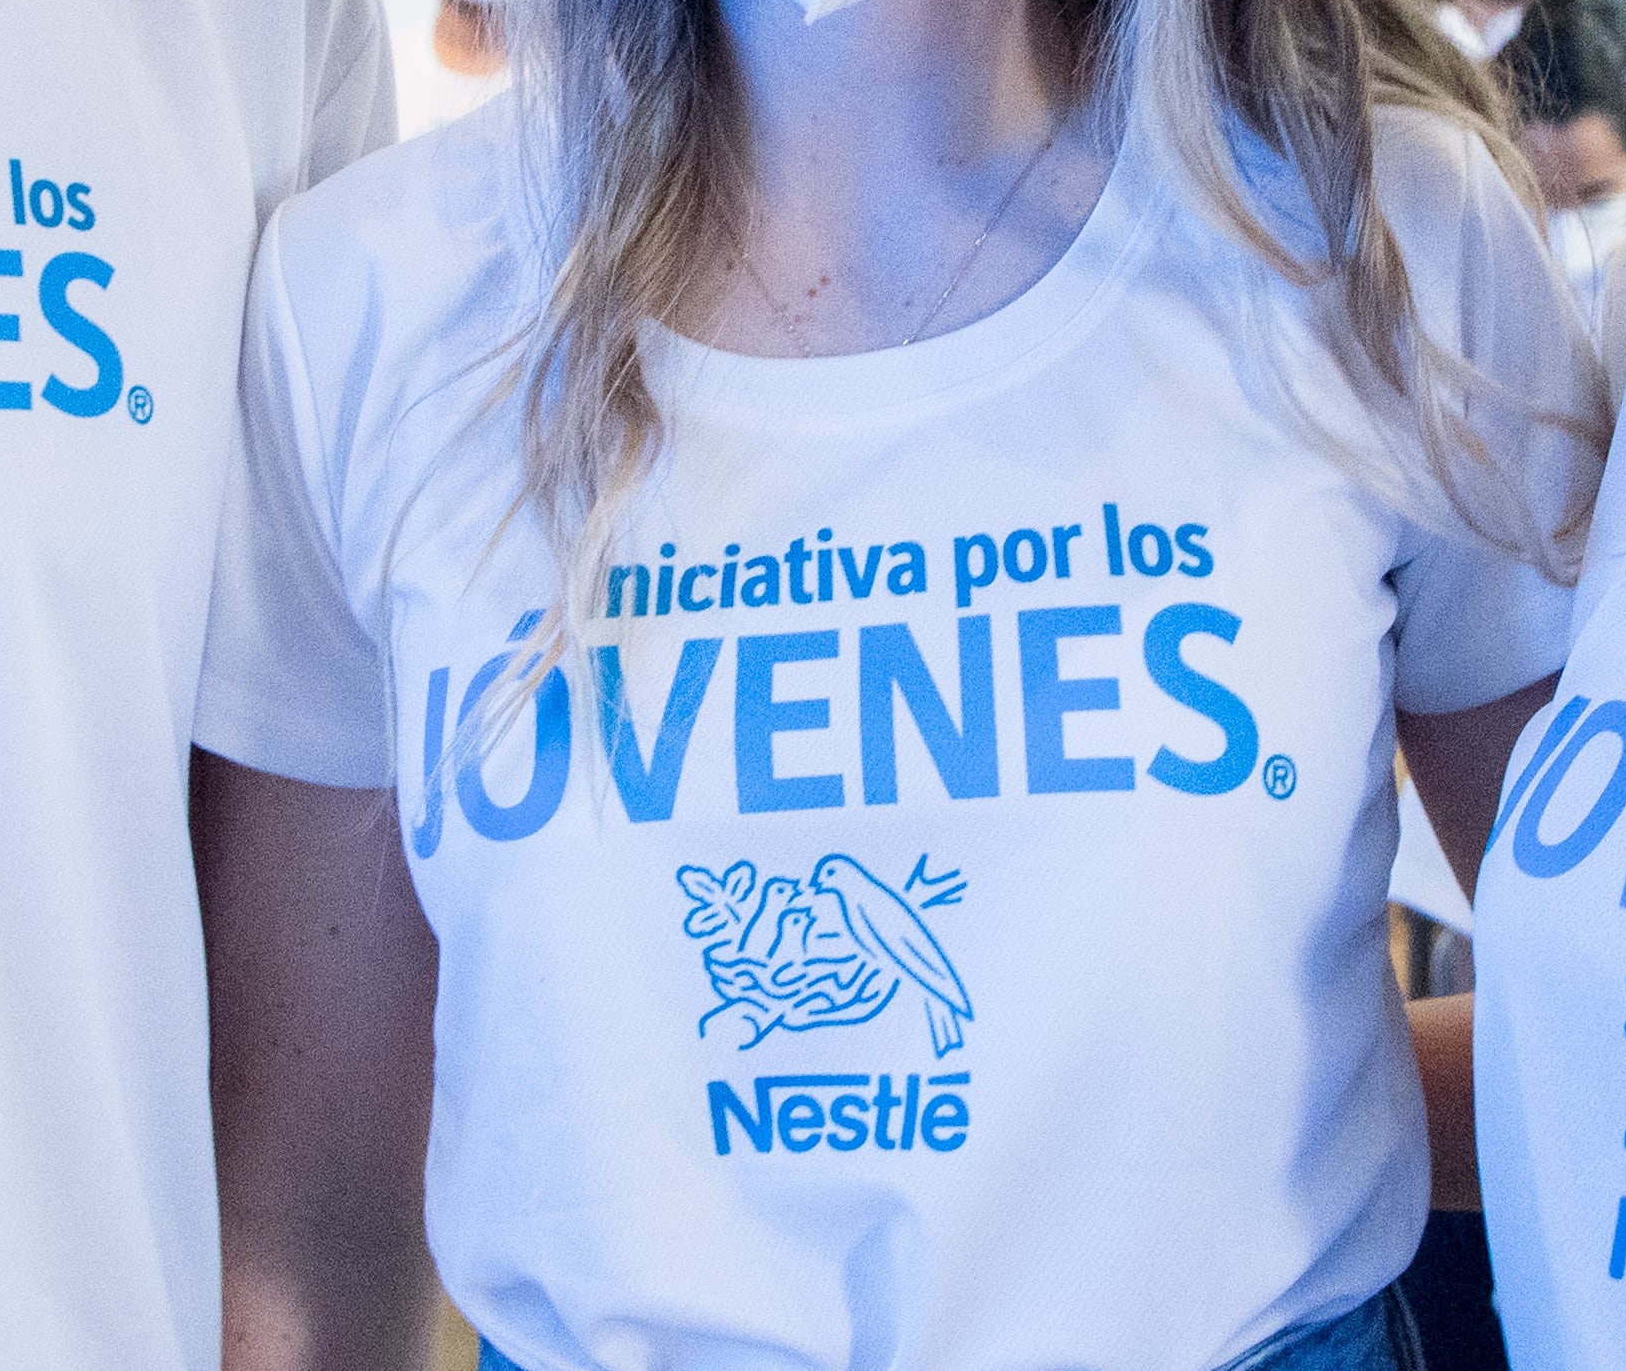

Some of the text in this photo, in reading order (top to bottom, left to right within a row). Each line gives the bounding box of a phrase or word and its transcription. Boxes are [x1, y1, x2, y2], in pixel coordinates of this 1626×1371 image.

[9, 158, 96, 232] los
[604, 502, 1214, 618] niciativa por los
[707, 1072, 972, 1156] Nestlé
